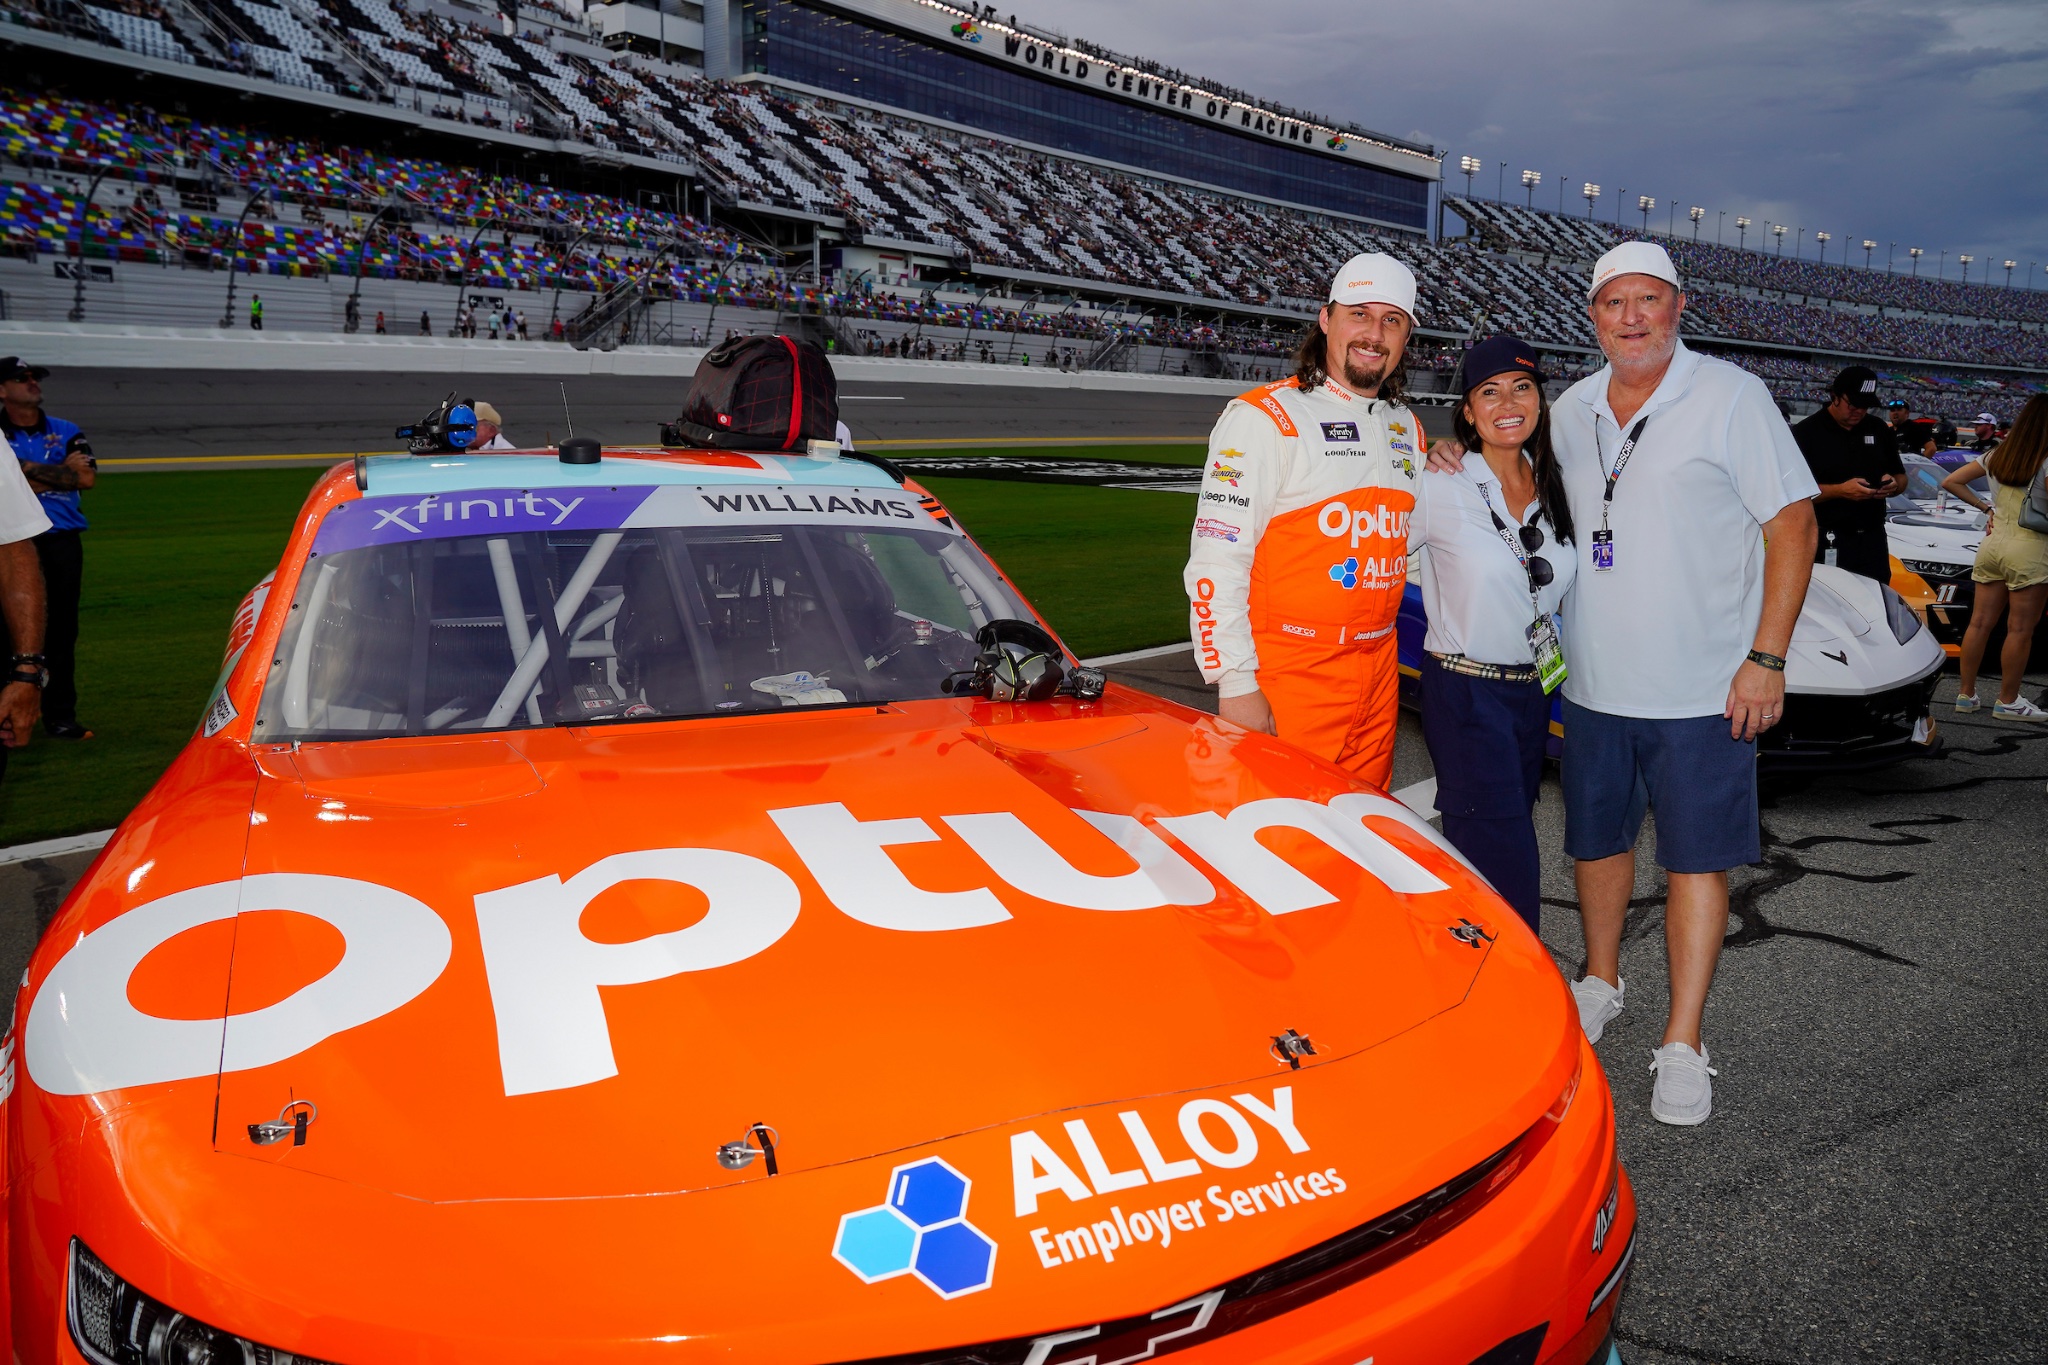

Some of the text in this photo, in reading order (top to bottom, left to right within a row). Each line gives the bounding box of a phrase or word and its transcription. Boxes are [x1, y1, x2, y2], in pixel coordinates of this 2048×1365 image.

[1004, 36, 1313, 145] WORLD CENTER OF RACING
[1348, 279, 1374, 289] Optum
[1615, 438, 1636, 473] NASCAR
[1210, 469, 1244, 480] SUNOCO
[371, 491, 917, 534] xfinity WILLIAMS
[1228, 493, 1250, 508] Well
[1499, 527, 1523, 559] NASCAR
[1936, 583, 1958, 603] 11
[1281, 623, 1316, 638] sparco
[1009, 1085, 1313, 1218] ALLOY
[1029, 1166, 1347, 1270] Employer Services
